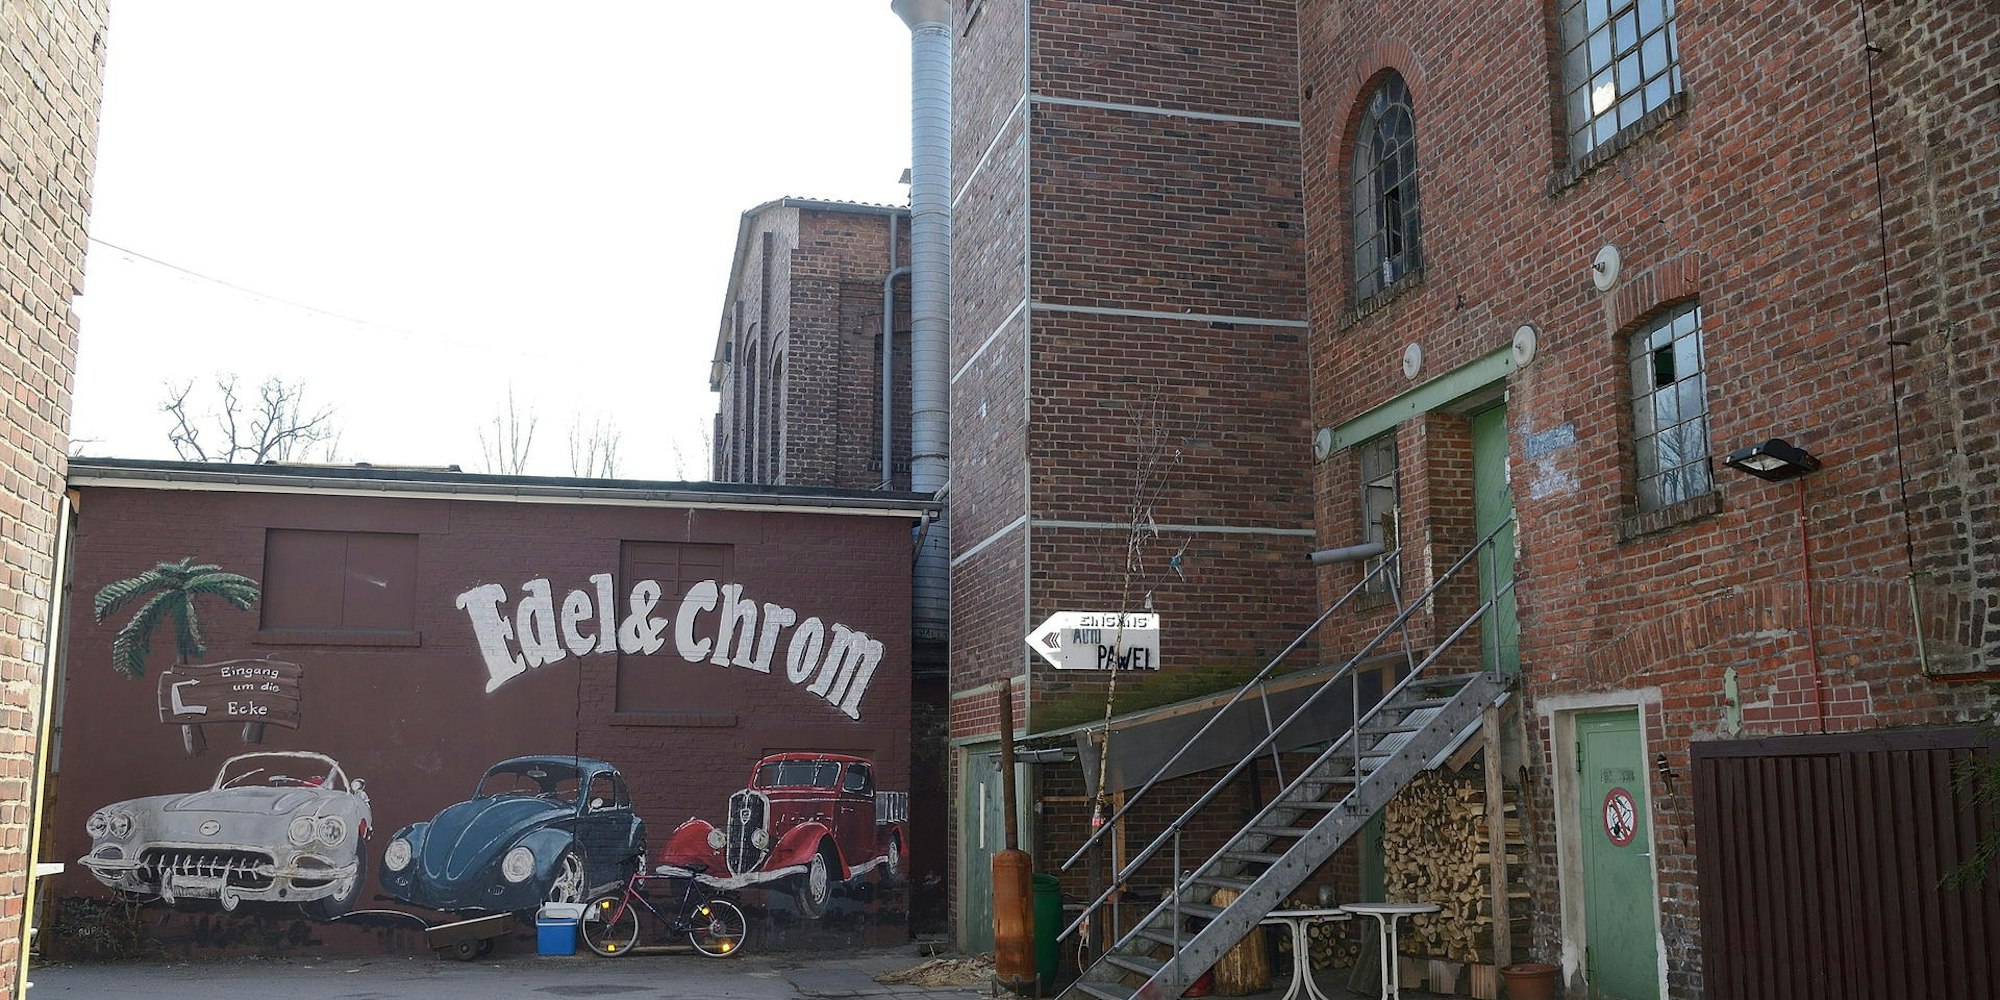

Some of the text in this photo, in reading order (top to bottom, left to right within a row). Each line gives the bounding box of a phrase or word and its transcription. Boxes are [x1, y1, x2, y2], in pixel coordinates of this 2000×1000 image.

[1073, 628, 1102, 645] AUTO
[1098, 645, 1156, 671] PAWEL
[221, 666, 279, 678] Eingang
[232, 682, 280, 692] um die
[227, 700, 268, 715] Ecke
